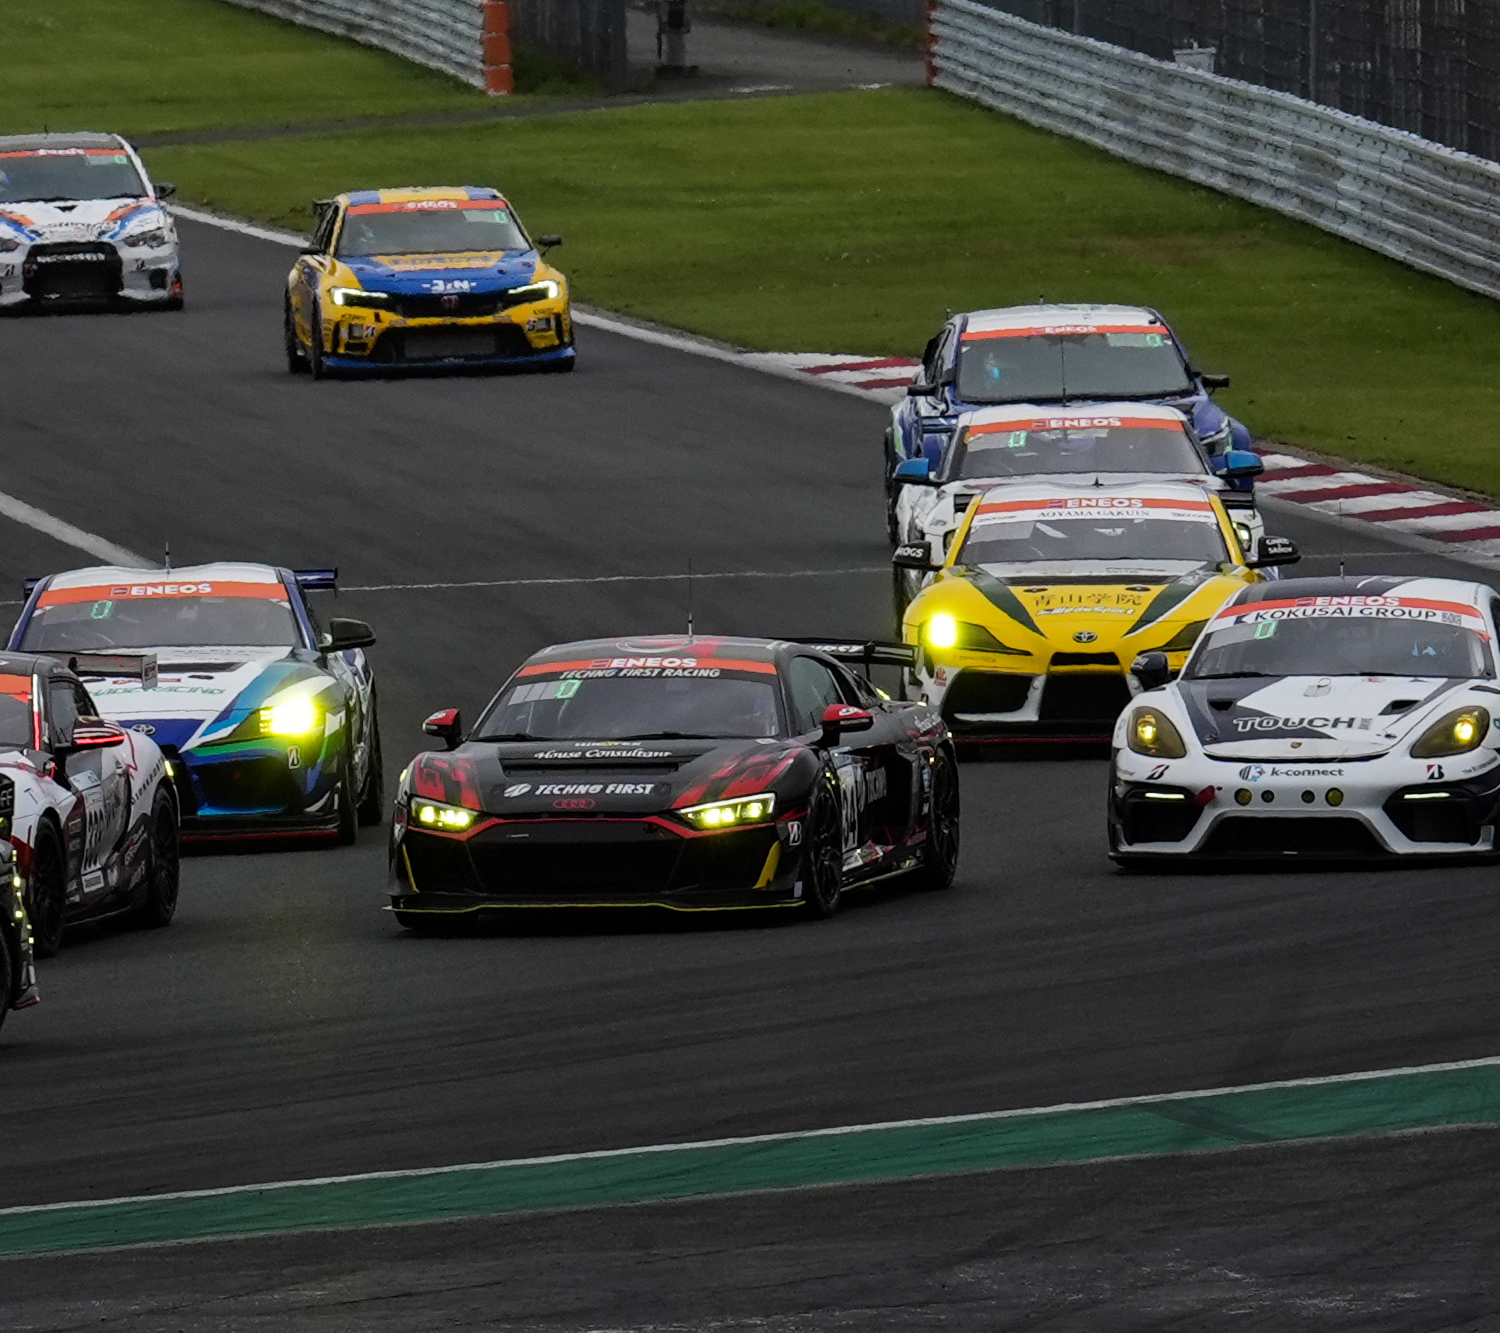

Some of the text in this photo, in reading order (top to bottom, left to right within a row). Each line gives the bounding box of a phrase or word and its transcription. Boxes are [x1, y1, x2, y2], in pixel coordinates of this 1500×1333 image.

[1050, 416, 1122, 429] ENEOS
[1066, 498, 1144, 509] ENEOS
[129, 582, 212, 597] ENEOS
[1315, 595, 1400, 607] ENEOS
[1254, 607, 1353, 623] KOKUSAI
[1359, 606, 1438, 621] GROUP
[610, 657, 698, 669] ENEOS
[559, 667, 721, 680] TECHNO FIRST RACING
[1233, 716, 1355, 732] TOUCH
[1269, 766, 1345, 777] k-connect
[533, 782, 657, 795] TECHNO FIRST
